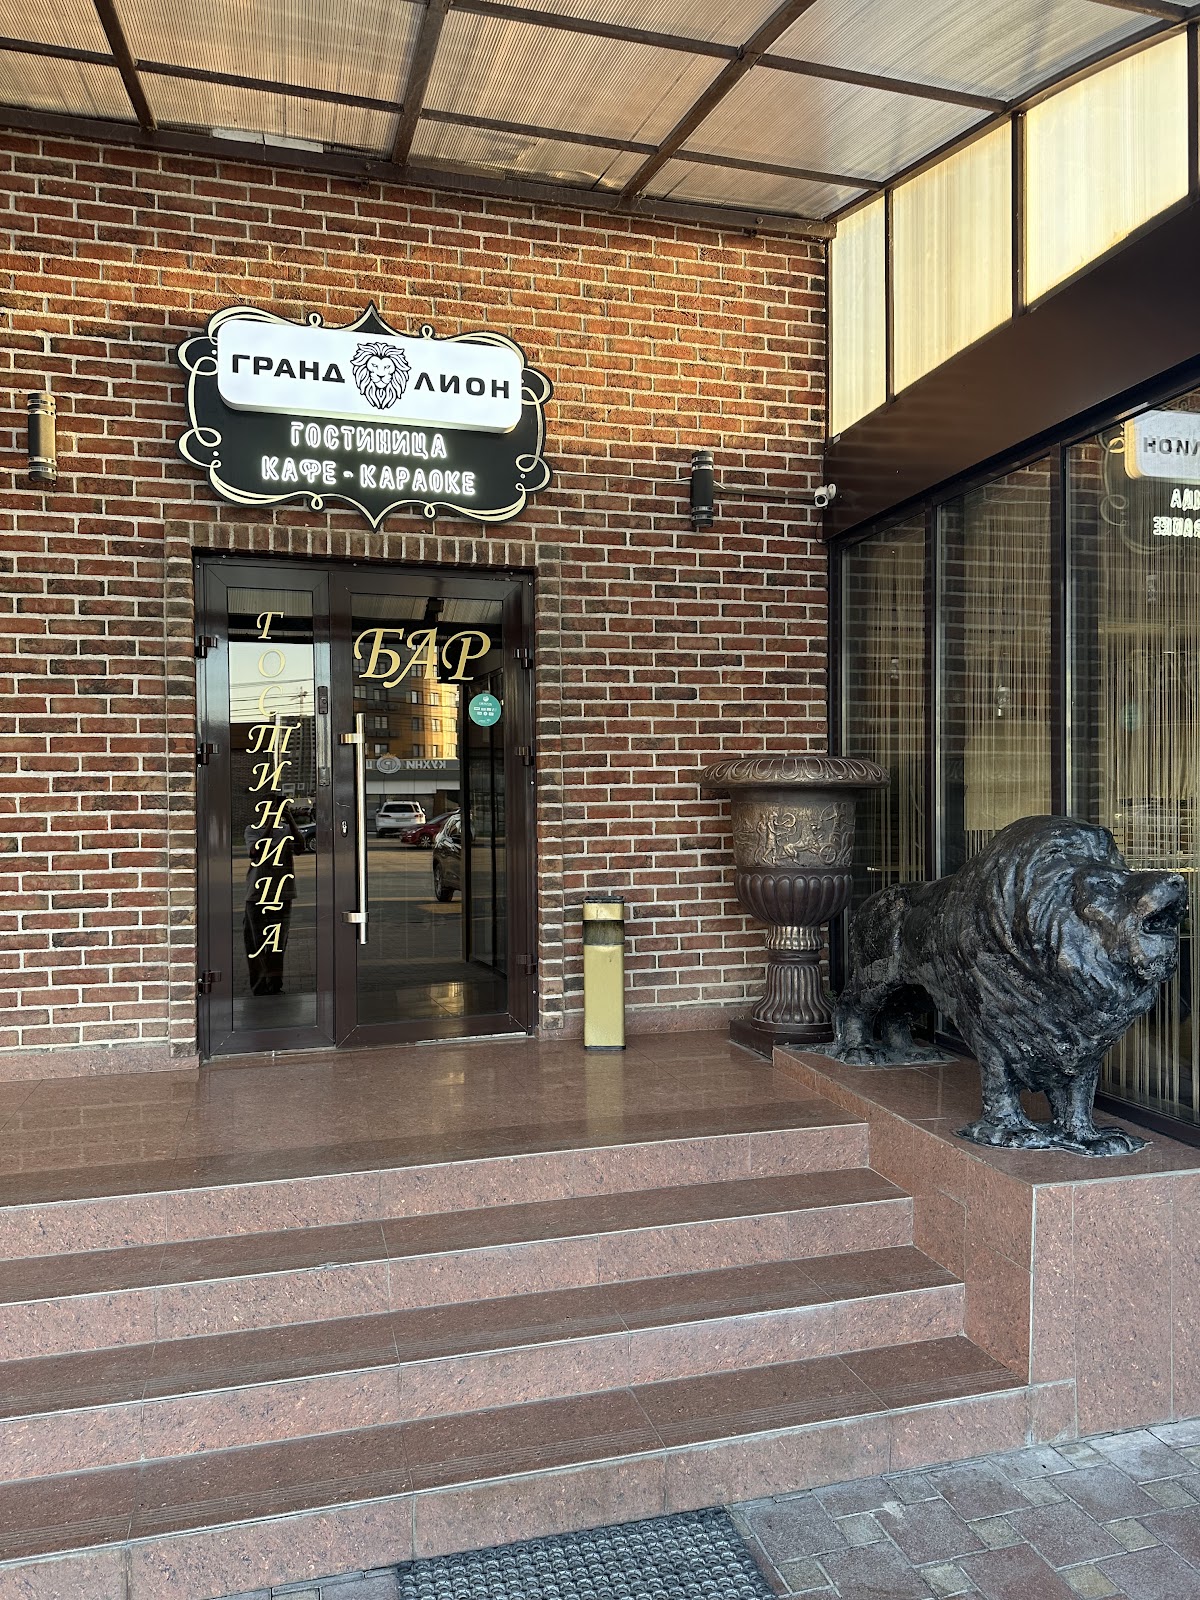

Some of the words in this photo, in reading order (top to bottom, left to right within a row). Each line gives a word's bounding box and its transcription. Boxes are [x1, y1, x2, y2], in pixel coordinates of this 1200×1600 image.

[232, 354, 346, 384] ГРАНД
[414, 372, 510, 399] ЛИОН
[290, 421, 447, 460] ГОСТИНИЦА
[261, 455, 337, 485] КАФЕ
[360, 464, 476, 496] КАРАОКЕ
[354, 626, 491, 689] БАР
[245, 611, 302, 959] ГОСТИНИЦА
